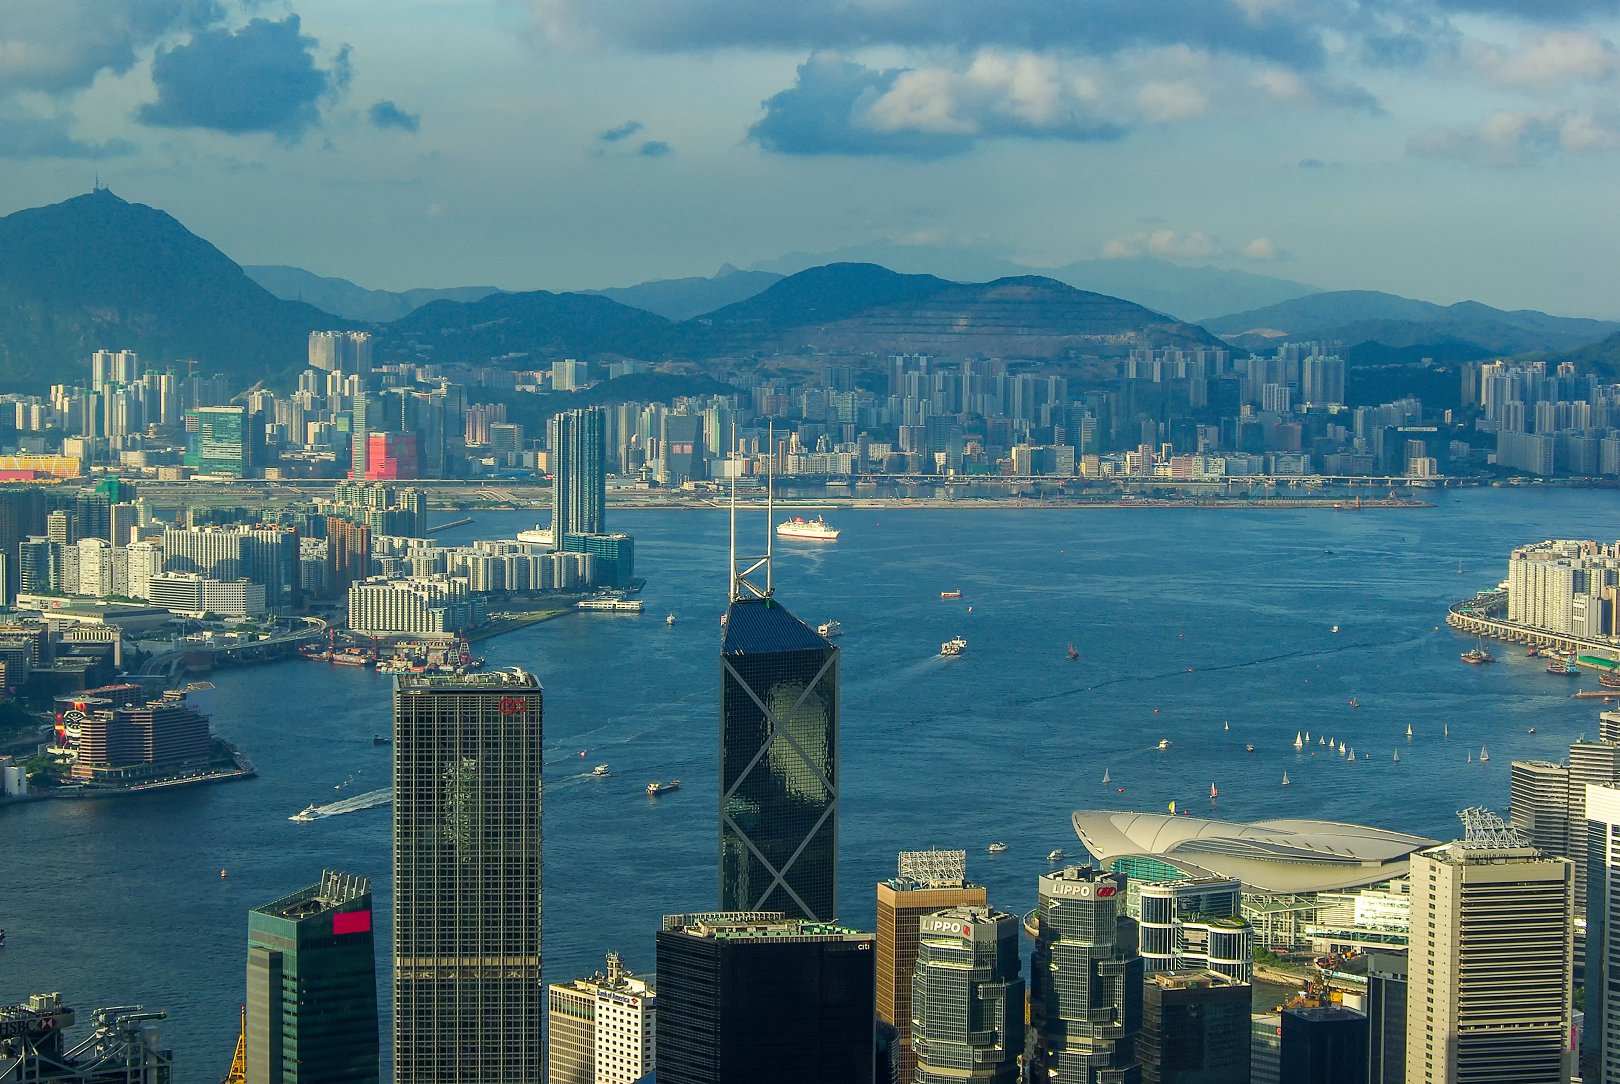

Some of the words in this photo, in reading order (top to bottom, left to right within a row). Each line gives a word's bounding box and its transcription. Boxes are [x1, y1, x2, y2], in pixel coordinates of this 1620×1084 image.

[1052, 883, 1090, 897] LIPPO
[922, 920, 961, 933] LIPPO
[857, 942, 870, 950] citi
[0, 1019, 36, 1034] HSBC
